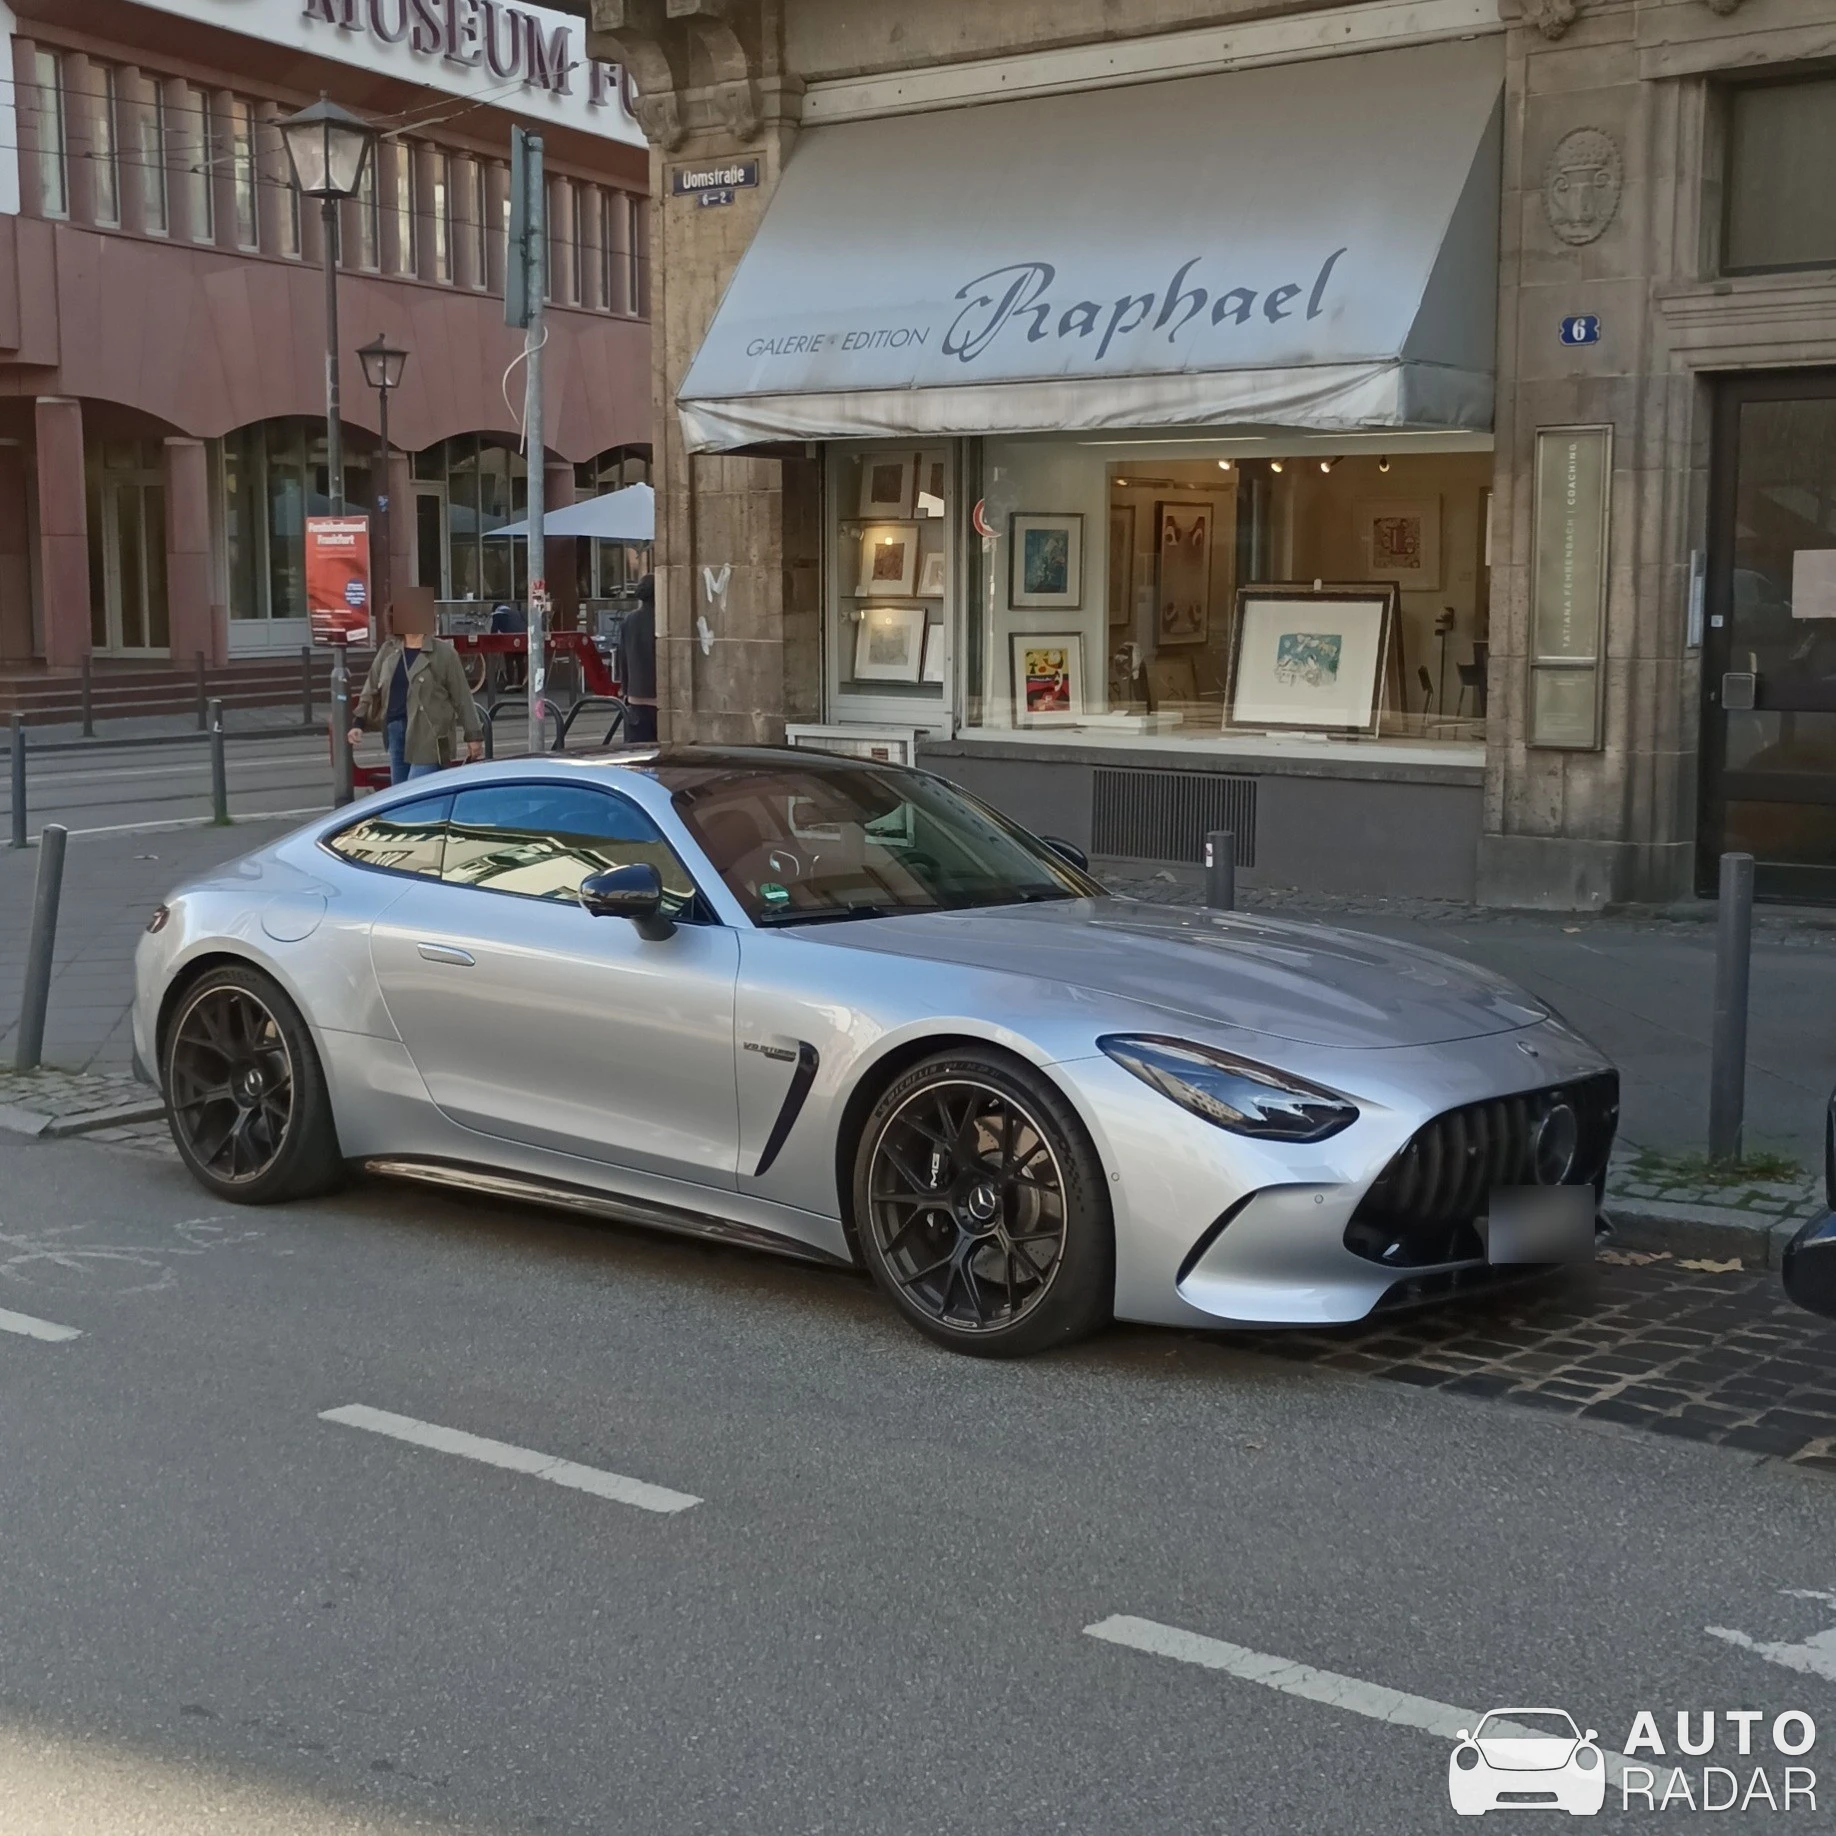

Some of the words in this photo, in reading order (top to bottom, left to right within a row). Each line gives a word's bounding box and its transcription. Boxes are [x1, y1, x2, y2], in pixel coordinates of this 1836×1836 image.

[942, 247, 1348, 363] Raphael
[746, 334, 825, 356] GALERIE
[841, 327, 930, 350] EDITION
[1572, 318, 1586, 341] 6
[1567, 443, 1577, 505] COACHING
[1563, 600, 1573, 647] TATIANA
